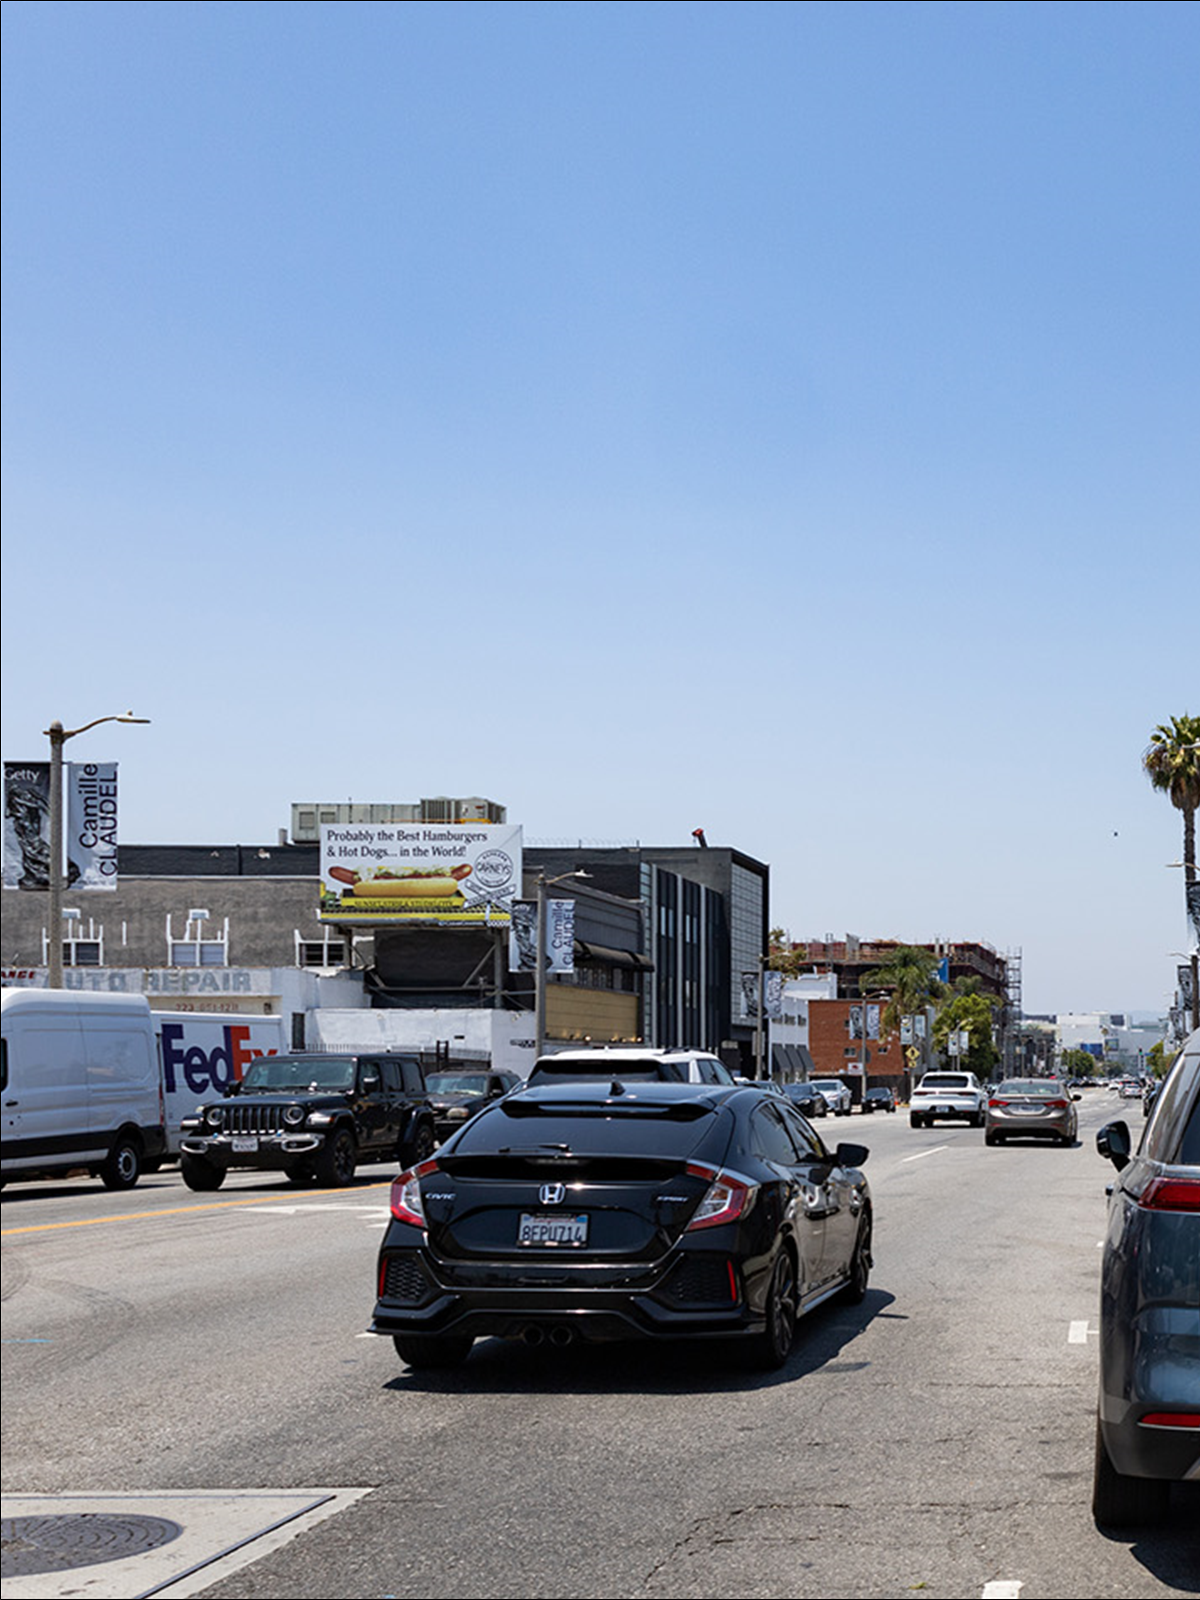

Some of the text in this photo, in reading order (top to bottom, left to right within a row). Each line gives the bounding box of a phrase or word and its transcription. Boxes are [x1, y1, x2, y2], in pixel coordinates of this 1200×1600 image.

[4, 766, 40, 783] Getty
[78, 763, 98, 848] Camille
[99, 770, 118, 876] CLAUDEL
[326, 829, 488, 844] Probably the Best Hamburgers
[326, 846, 467, 860] & Hot Dogs... in the World!
[551, 901, 565, 949] Camille
[563, 902, 576, 965] CLAUDEL
[145, 972, 252, 992] REPAIR
[161, 1023, 278, 1094] FedE
[522, 1224, 582, 1242] 8FPU714
